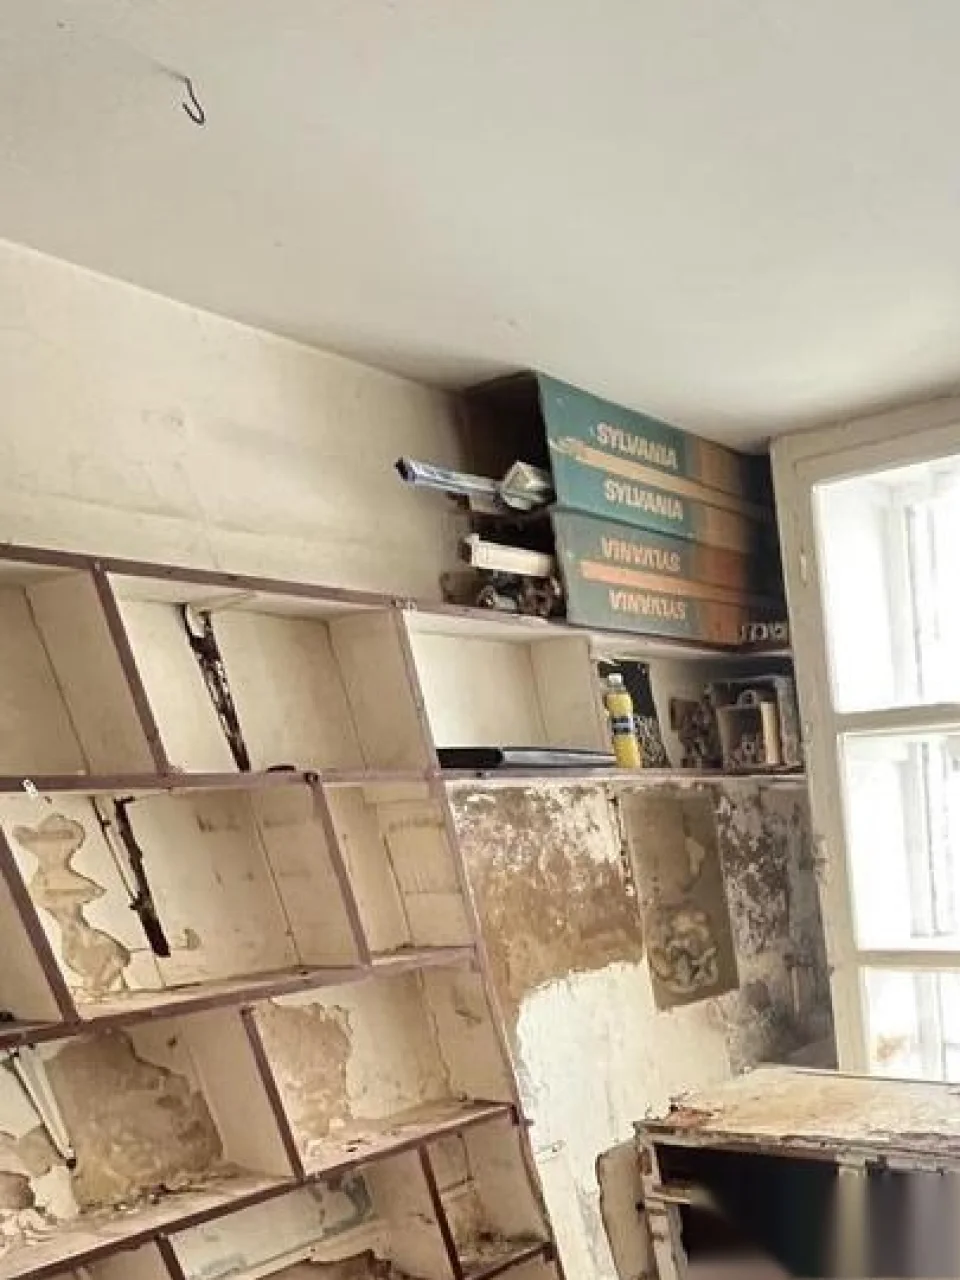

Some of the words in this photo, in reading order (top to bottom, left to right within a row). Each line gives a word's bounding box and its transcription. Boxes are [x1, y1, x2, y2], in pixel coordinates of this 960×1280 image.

[597, 422, 678, 470] SYLVANIA
[605, 479, 684, 520] SYLVANIA
[602, 537, 680, 573] SYLVANIA
[608, 590, 686, 620] SYLVANIA
